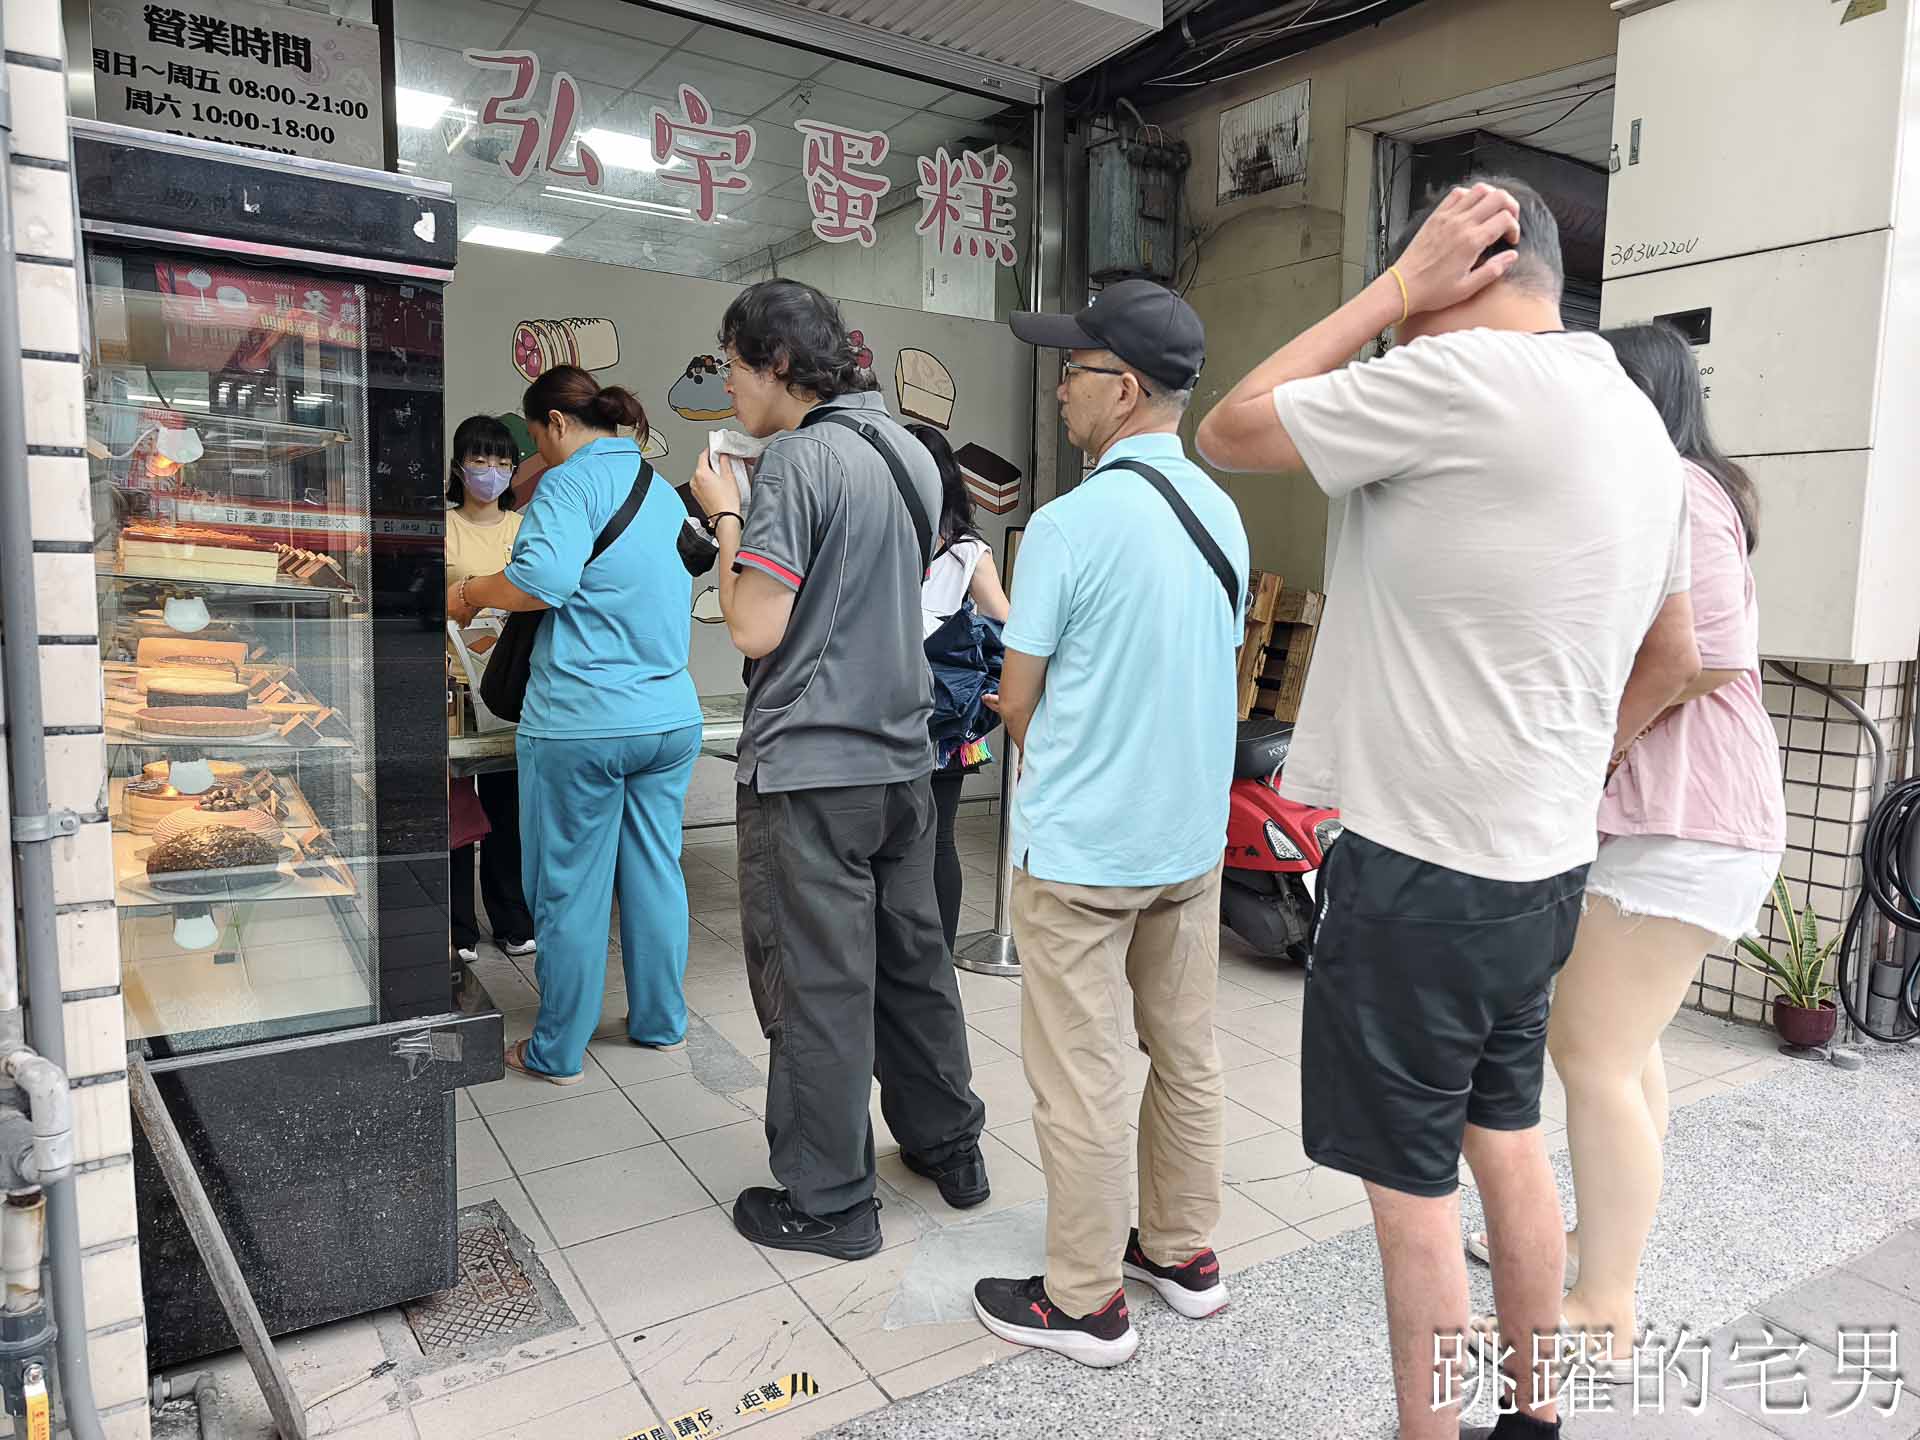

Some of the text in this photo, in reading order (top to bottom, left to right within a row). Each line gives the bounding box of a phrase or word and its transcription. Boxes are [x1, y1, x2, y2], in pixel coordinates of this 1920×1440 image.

[144, 3, 313, 74] 營業時間
[125, 86, 182, 119] 周六
[191, 102, 336, 145] 10:00-18:00
[228, 77, 369, 120] 08:00-21:00
[463, 48, 1018, 267] 弘宇蛋糕
